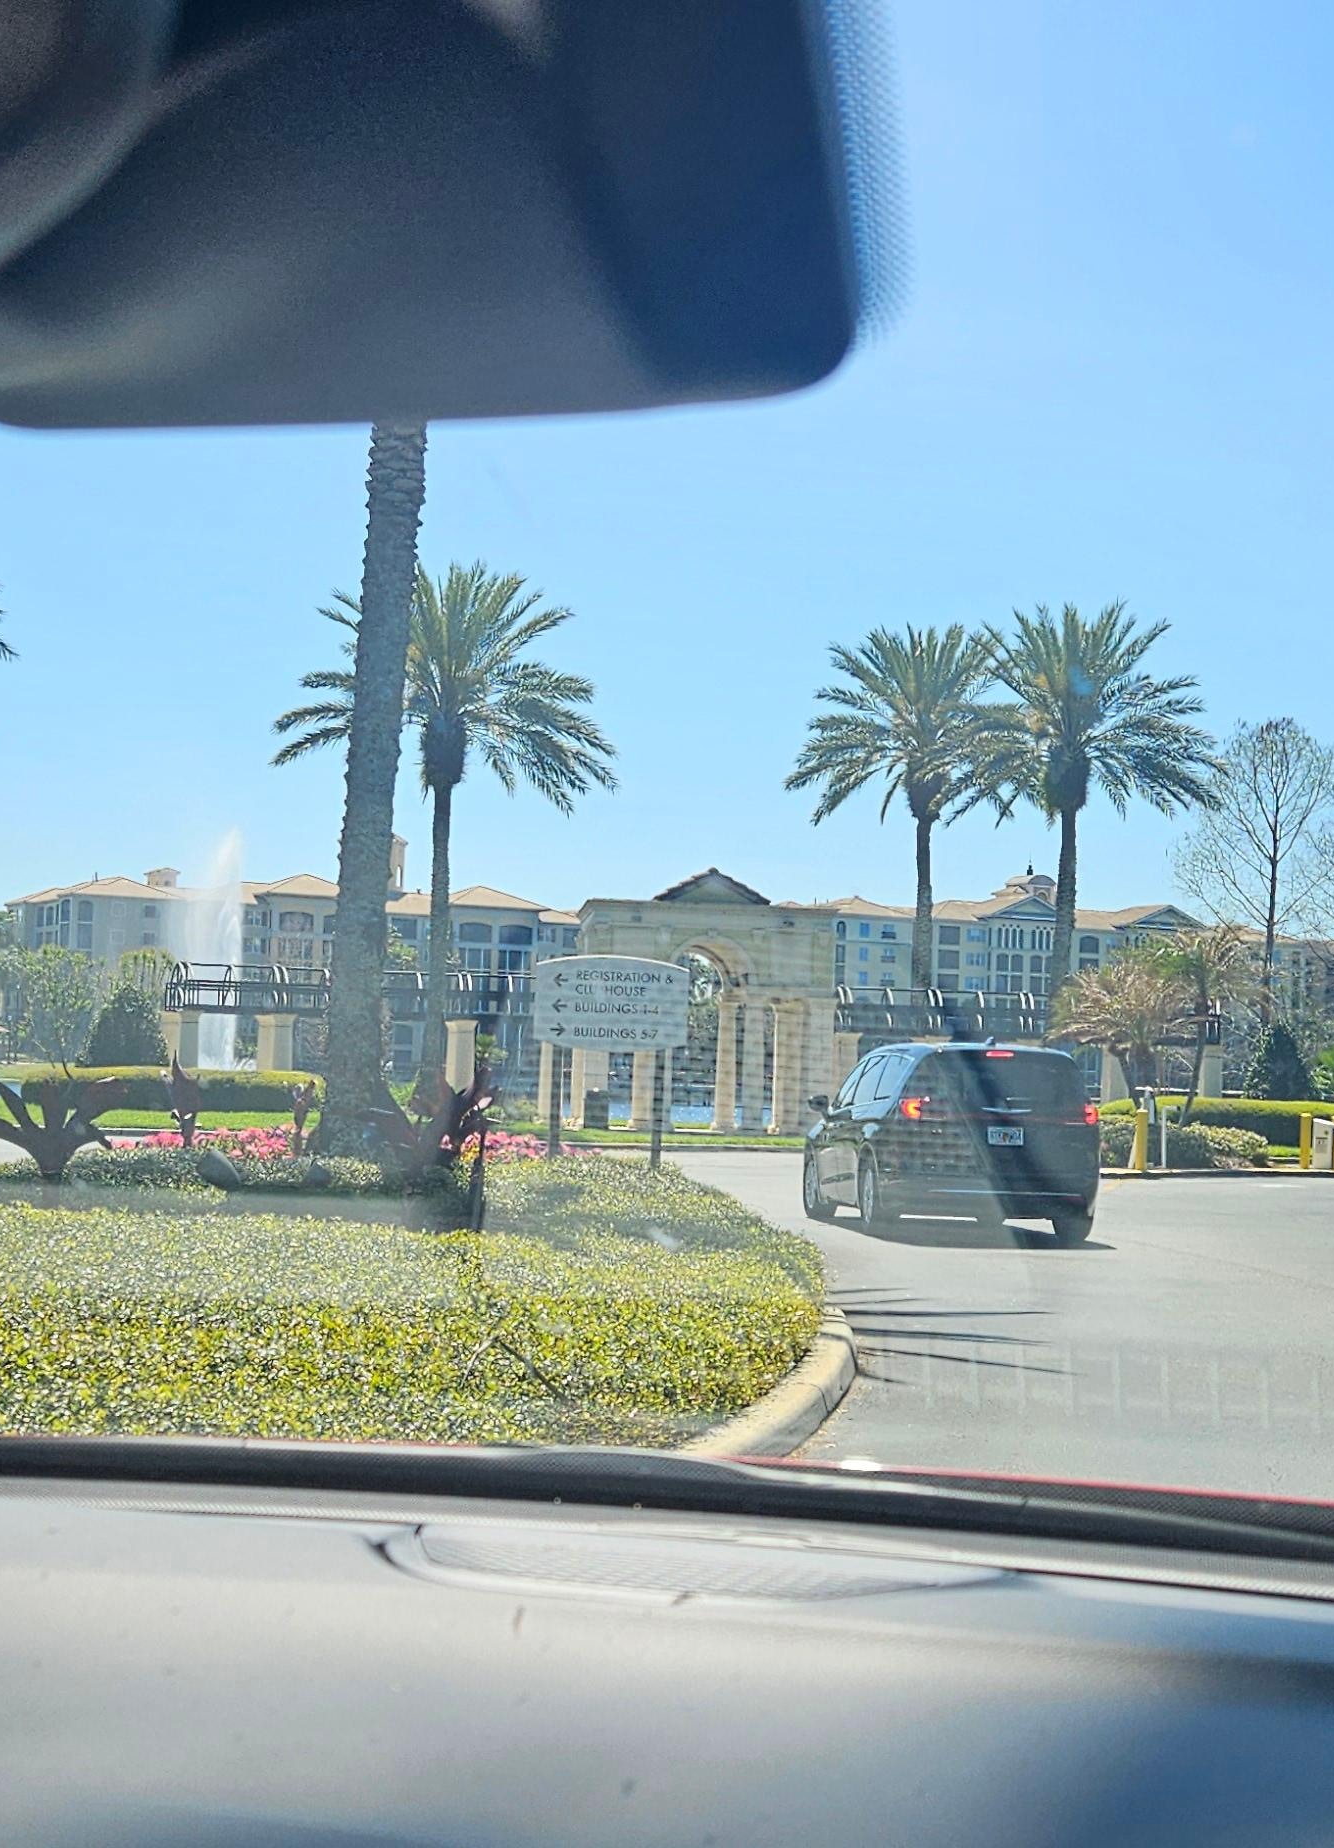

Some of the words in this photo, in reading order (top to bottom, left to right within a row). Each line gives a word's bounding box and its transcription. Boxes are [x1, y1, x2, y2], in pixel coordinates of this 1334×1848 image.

[576, 970, 661, 983] REGISTRATION
[665, 975, 674, 984] &
[575, 1002, 638, 1014] BUILDINGS
[642, 1004, 659, 1015] 1-4
[574, 1027, 637, 1039] BUILDINGS
[641, 1029, 658, 1039] 5-7
